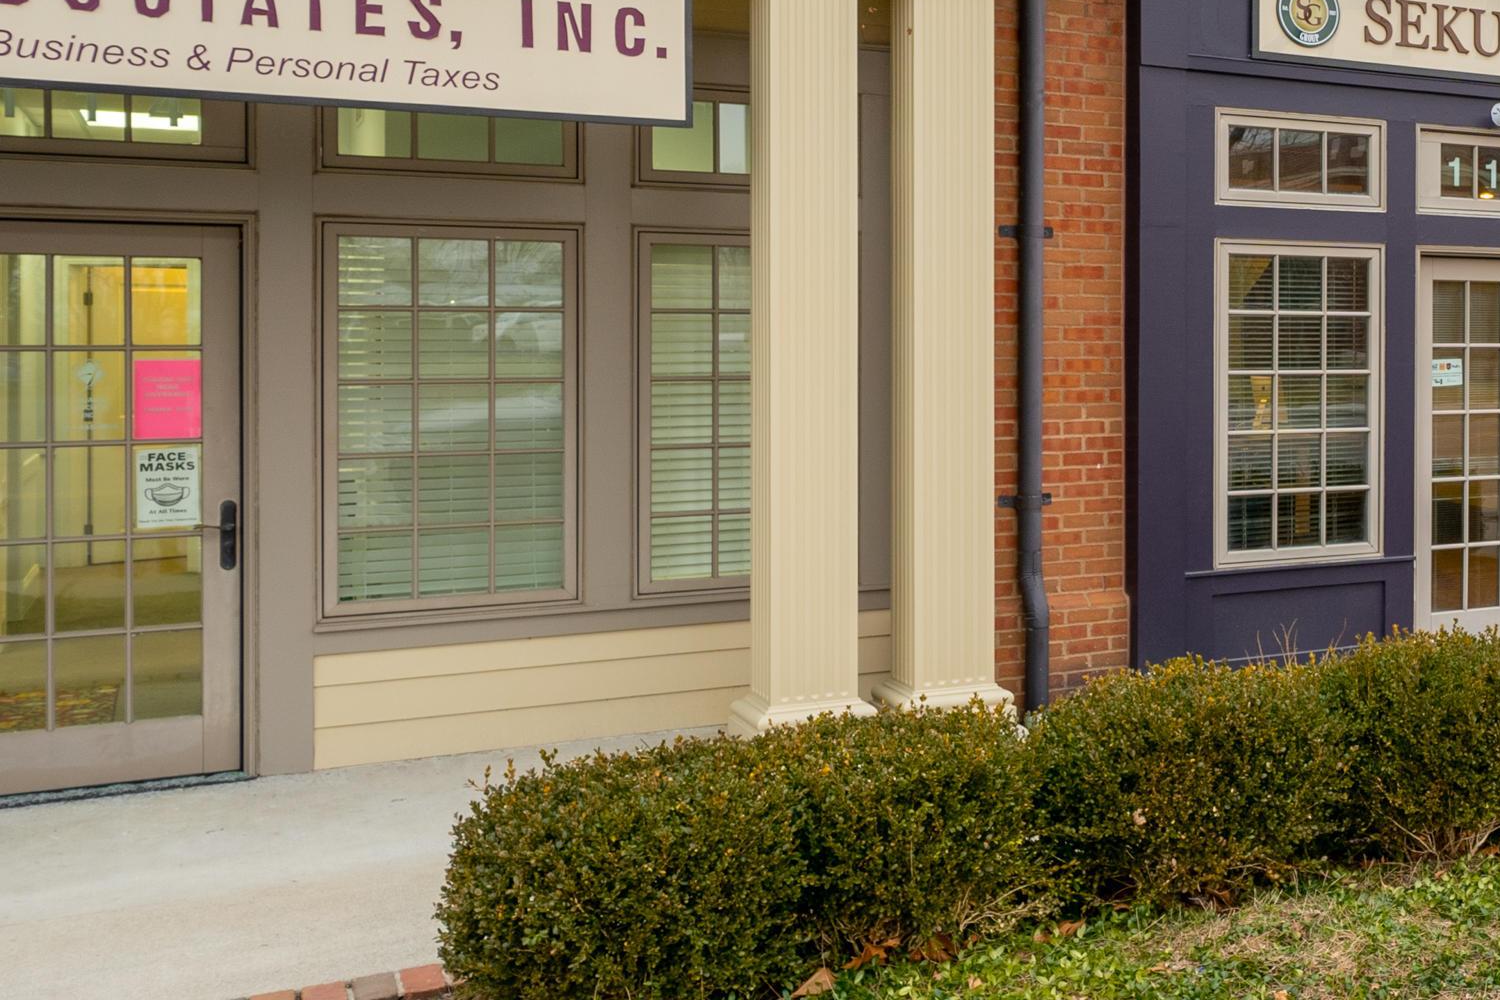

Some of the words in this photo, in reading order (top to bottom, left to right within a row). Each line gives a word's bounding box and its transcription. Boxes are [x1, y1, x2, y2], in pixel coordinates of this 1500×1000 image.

[187, 44, 212, 72] &
[226, 46, 389, 84] Personal
[403, 59, 501, 91] Taxes
[147, 452, 186, 461] FACE
[140, 461, 195, 472] MASKS
